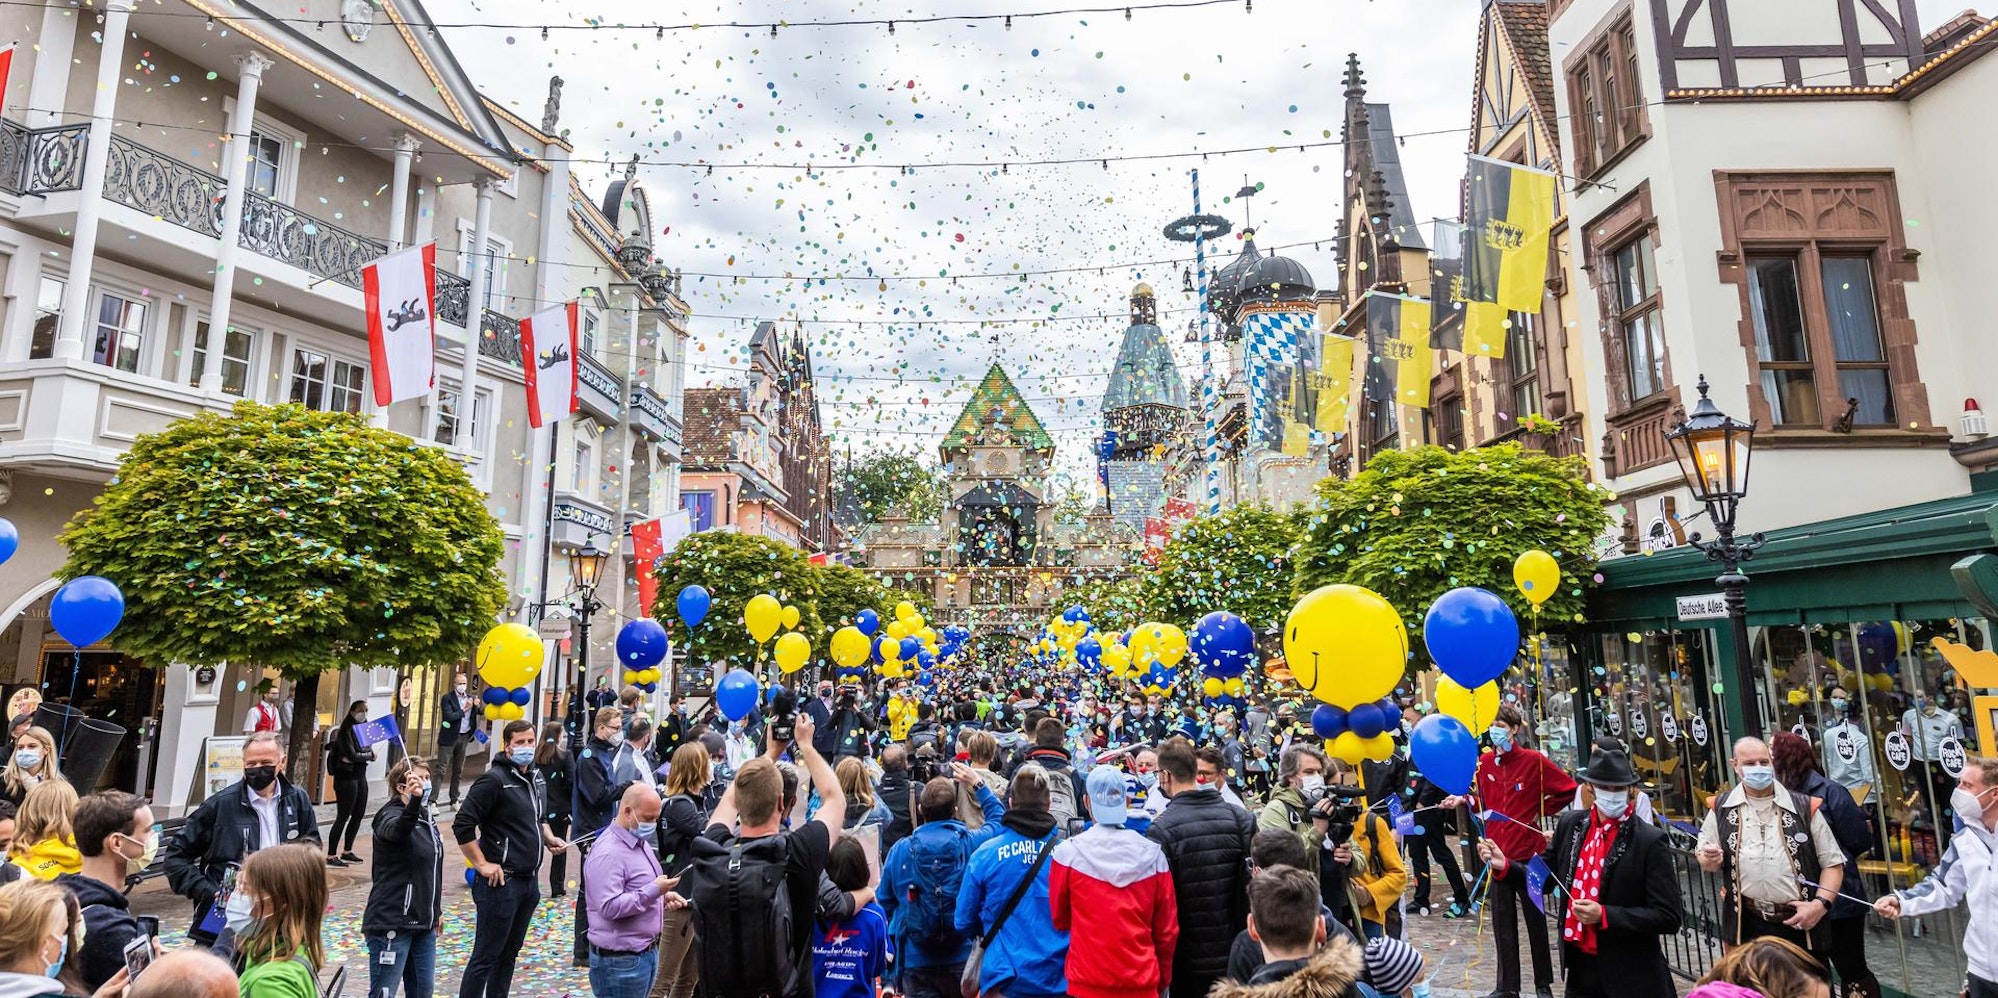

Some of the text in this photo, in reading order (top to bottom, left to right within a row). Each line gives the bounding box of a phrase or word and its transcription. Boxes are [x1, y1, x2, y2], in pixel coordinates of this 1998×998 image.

[1649, 536, 1673, 551] ROCK
[1679, 599, 1724, 616] Deutsche Allee
[1837, 737, 1854, 746] ROCK
[1888, 740, 1906, 751] ROCK
[1840, 746, 1854, 756] CAFE
[1891, 751, 1907, 762] CAFE
[1943, 745, 1963, 758] ROCK
[1946, 758, 1963, 769] CAFE
[998, 844, 1011, 862] FC
[1011, 840, 1038, 857] CARL
[1022, 854, 1038, 864] JEN
